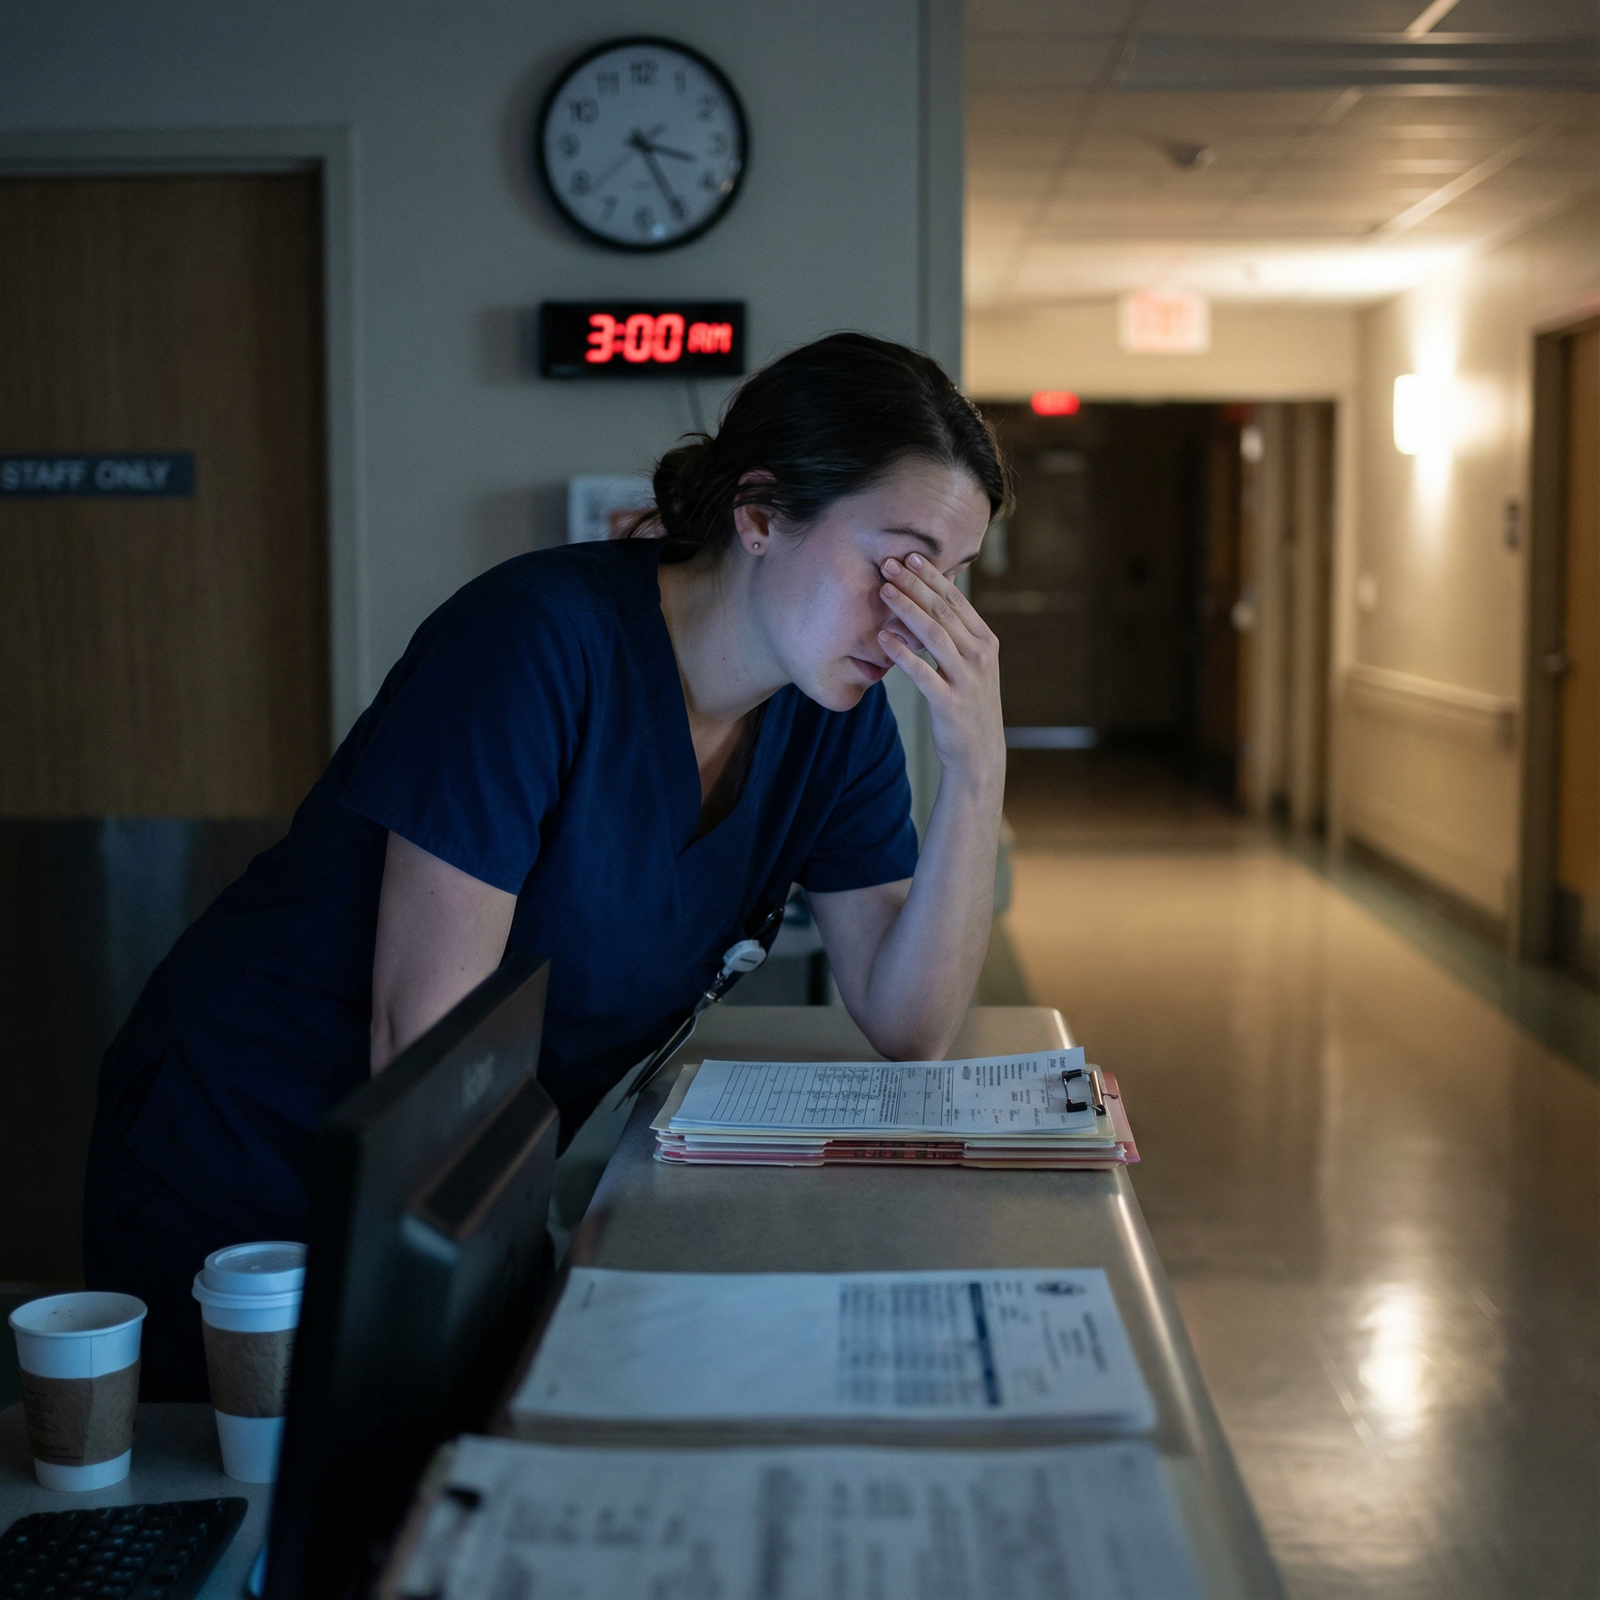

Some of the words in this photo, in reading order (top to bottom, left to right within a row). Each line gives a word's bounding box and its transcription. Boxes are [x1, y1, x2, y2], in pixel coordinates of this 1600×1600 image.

[597, 69, 620, 95] 11
[630, 58, 658, 86] 12
[674, 69, 686, 95] 1
[569, 97, 599, 125] 10
[696, 94, 717, 122] 2
[558, 132, 581, 160] 9
[708, 131, 729, 157] 3
[570, 168, 592, 196] 8
[602, 195, 618, 222] 7
[633, 205, 655, 231] 6
[585, 313, 686, 364] 3:00
[687, 322, 733, 354] AM
[1, 459, 88, 491] STAFF
[94, 459, 172, 491] ONLY
